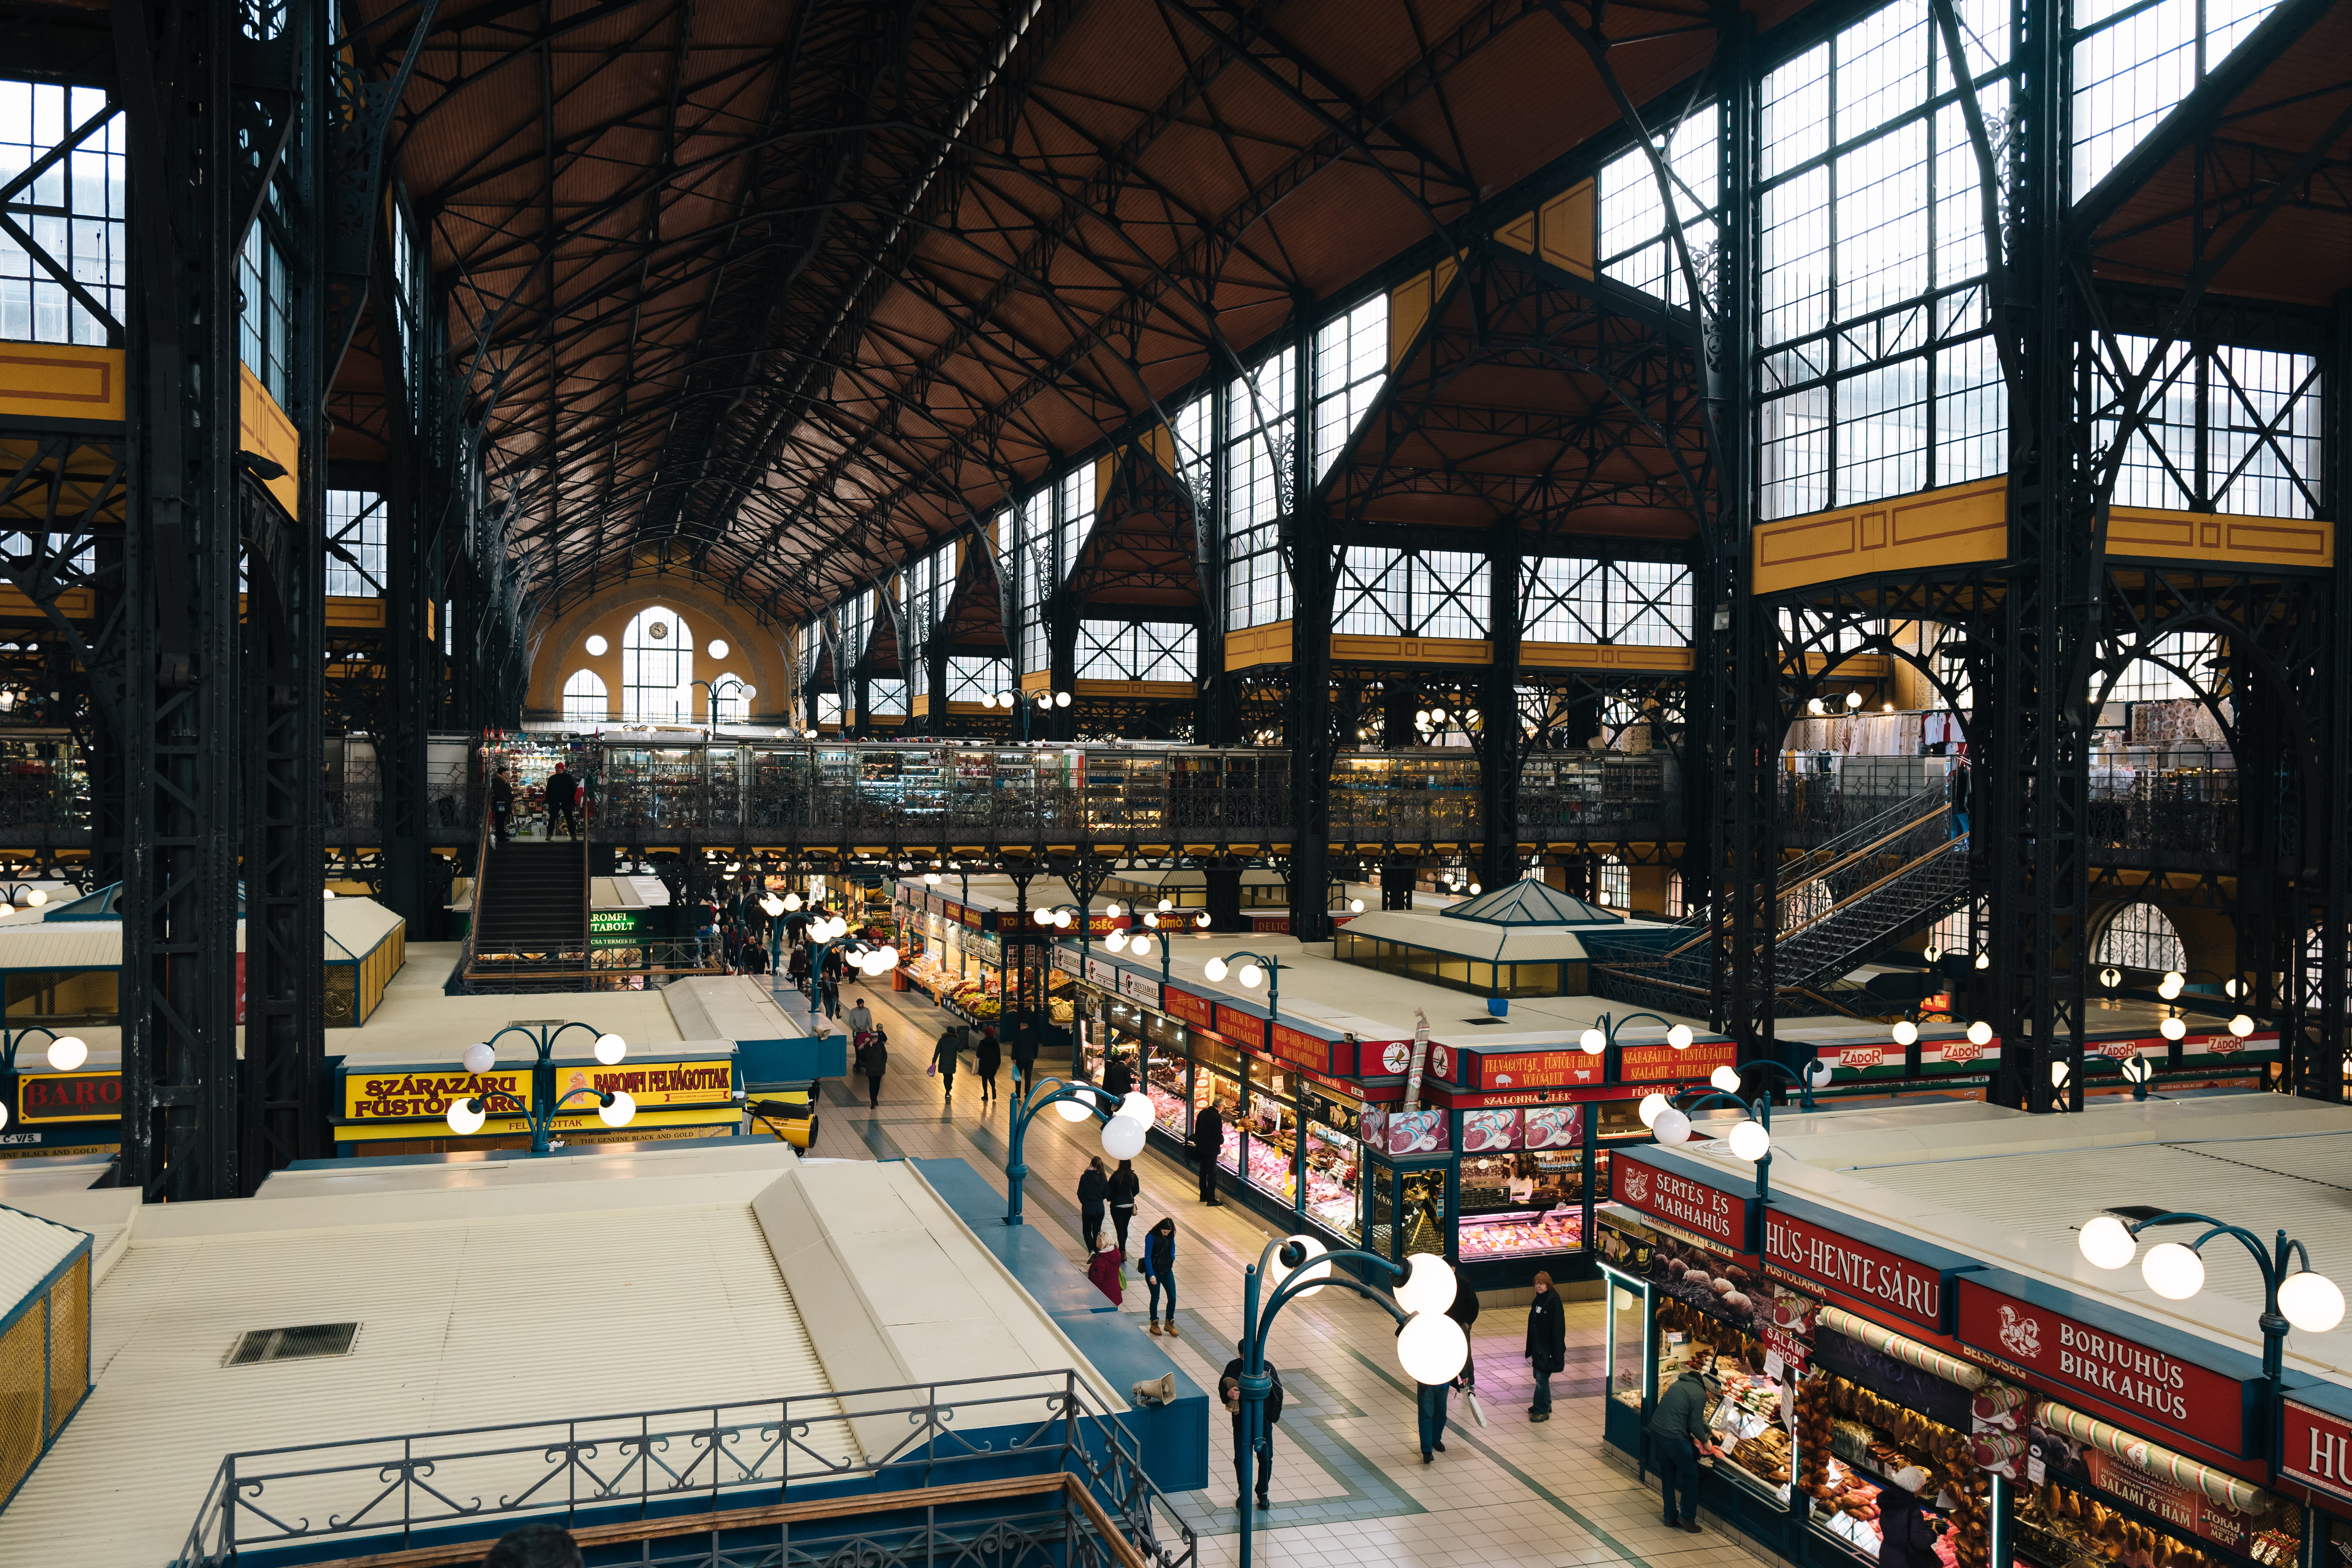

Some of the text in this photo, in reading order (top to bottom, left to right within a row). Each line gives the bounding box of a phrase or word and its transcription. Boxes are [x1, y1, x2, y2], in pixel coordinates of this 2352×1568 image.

[591, 922, 634, 931] TABOLT
[1259, 922, 1290, 931] DELIC
[1134, 981, 1157, 996] MINTABOLT
[1230, 1010, 1249, 1028] HUSOK
[1220, 1021, 1261, 1048] HENTESÁRUK
[2210, 1036, 2244, 1050] ZÁDOR
[1387, 1043, 1406, 1051] SZABÓ
[1623, 1044, 1733, 1064] SZÁRAZÁRUK FÜSTÖLTÁRUK
[1842, 1049, 1881, 1064] ZÁDOR
[1943, 1044, 1981, 1058] ZÁDOR
[2100, 1043, 2134, 1056] ZÁDOR
[1485, 1052, 1601, 1073] FELVÁGOTTAK FÜSTÖLT HUSOK
[1631, 1063, 1669, 1080] SZALÁMIK
[365, 1074, 517, 1097] SZÁRAZÁRU
[593, 1063, 729, 1095] BAROMFI FELVÁGOTTAK
[1523, 1069, 1564, 1086] VÖRÖSÁRUK
[1483, 1091, 1572, 1105] SZALONNAÉLÉK
[1656, 1174, 1729, 1214] SERTÉS ÉS
[1654, 1192, 1730, 1237] MARHAHÚS
[1621, 1221, 1635, 1232] GOLD
[1765, 1220, 1939, 1318] HÚS-HENTESÁRU
[1767, 1327, 1805, 1358] SALAMI
[1771, 1343, 1799, 1367] SHOP
[2060, 1322, 2184, 1389] BORJUHÚS
[2060, 1350, 2187, 1420] BIRKAHÚS
[2101, 1468, 2192, 1513] HUNGARIAN DELICATESS
[2100, 1474, 2191, 1528] SALAMI & HAM
[2205, 1508, 2241, 1534] TOKAJ
[2210, 1522, 2238, 1539] VICINITAS
[2210, 1529, 2236, 1546] MEAT
